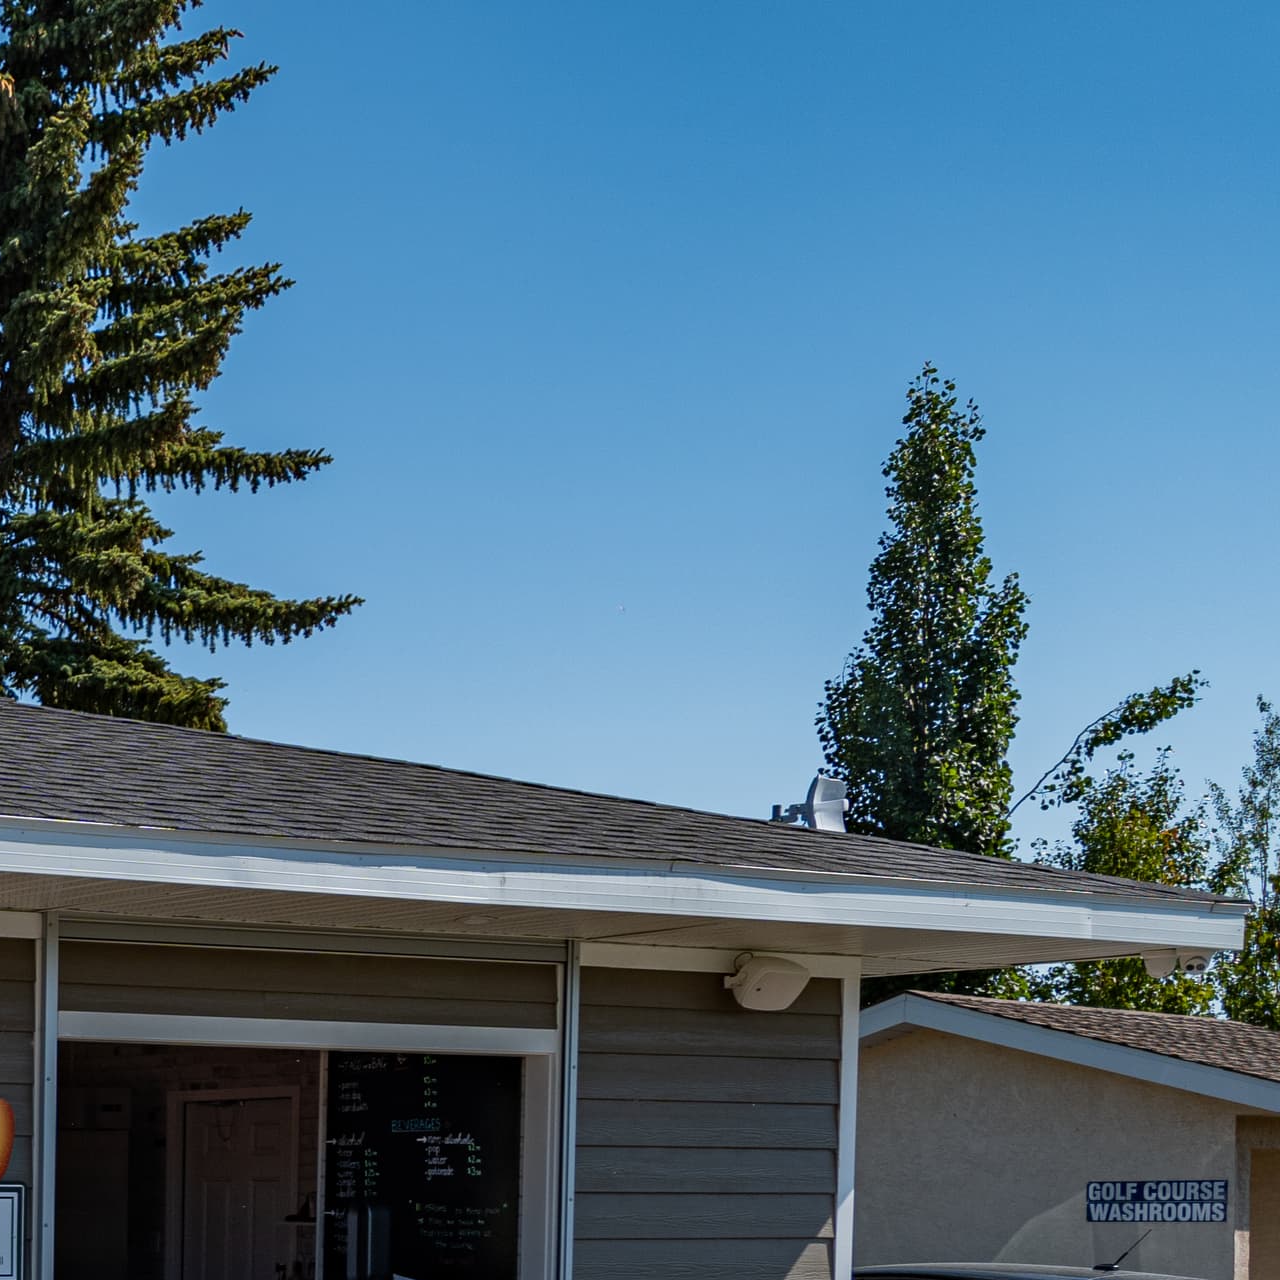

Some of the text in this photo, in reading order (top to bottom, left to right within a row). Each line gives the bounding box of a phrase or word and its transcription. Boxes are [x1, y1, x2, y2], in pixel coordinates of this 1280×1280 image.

[391, 1119, 441, 1131] BEVERAGES
[1088, 1181, 1225, 1200] GOLF COURSE
[1090, 1203, 1225, 1221] WASHROOMS
